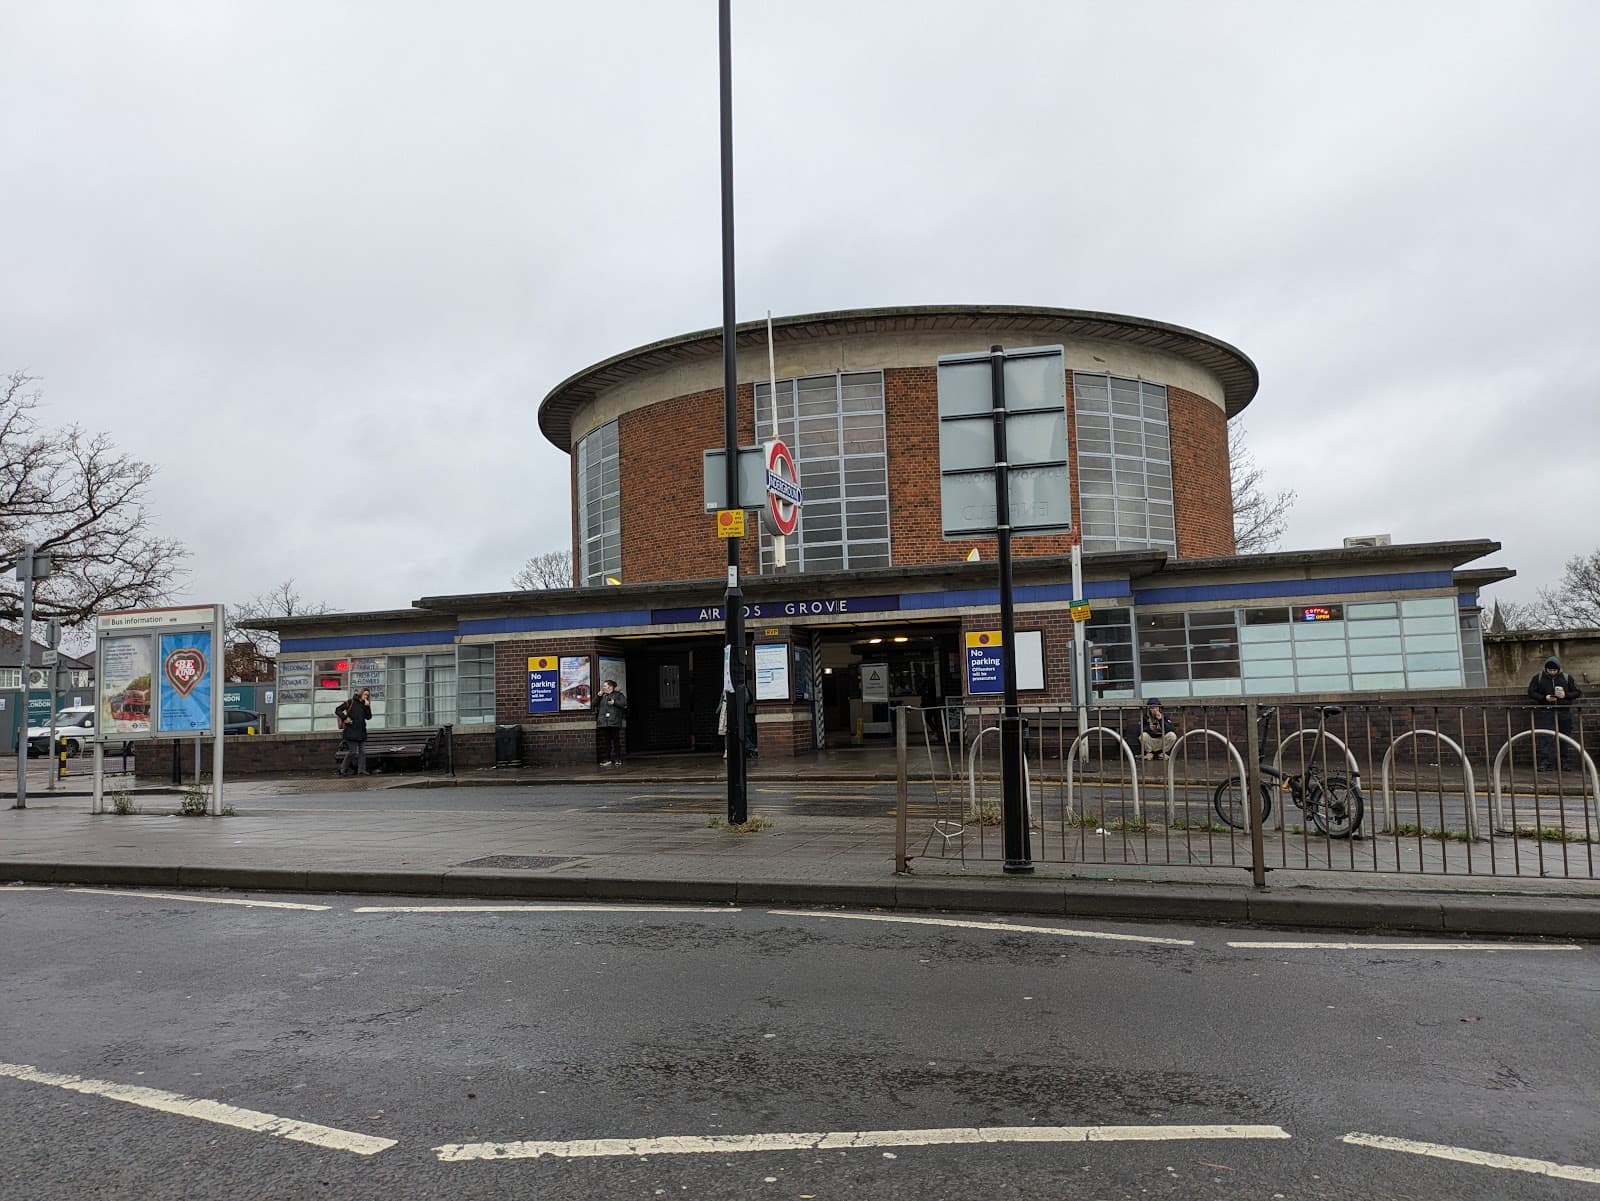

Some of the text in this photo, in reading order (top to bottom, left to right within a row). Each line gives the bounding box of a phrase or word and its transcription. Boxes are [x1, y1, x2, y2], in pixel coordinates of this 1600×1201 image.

[785, 600, 848, 615] GROVE
[124, 616, 163, 625] information
[970, 649, 983, 657] No
[175, 659, 194, 669] BE
[971, 657, 1001, 667] parking
[175, 668, 195, 681] KIND
[531, 672, 542, 681] No
[531, 680, 556, 690] parking
